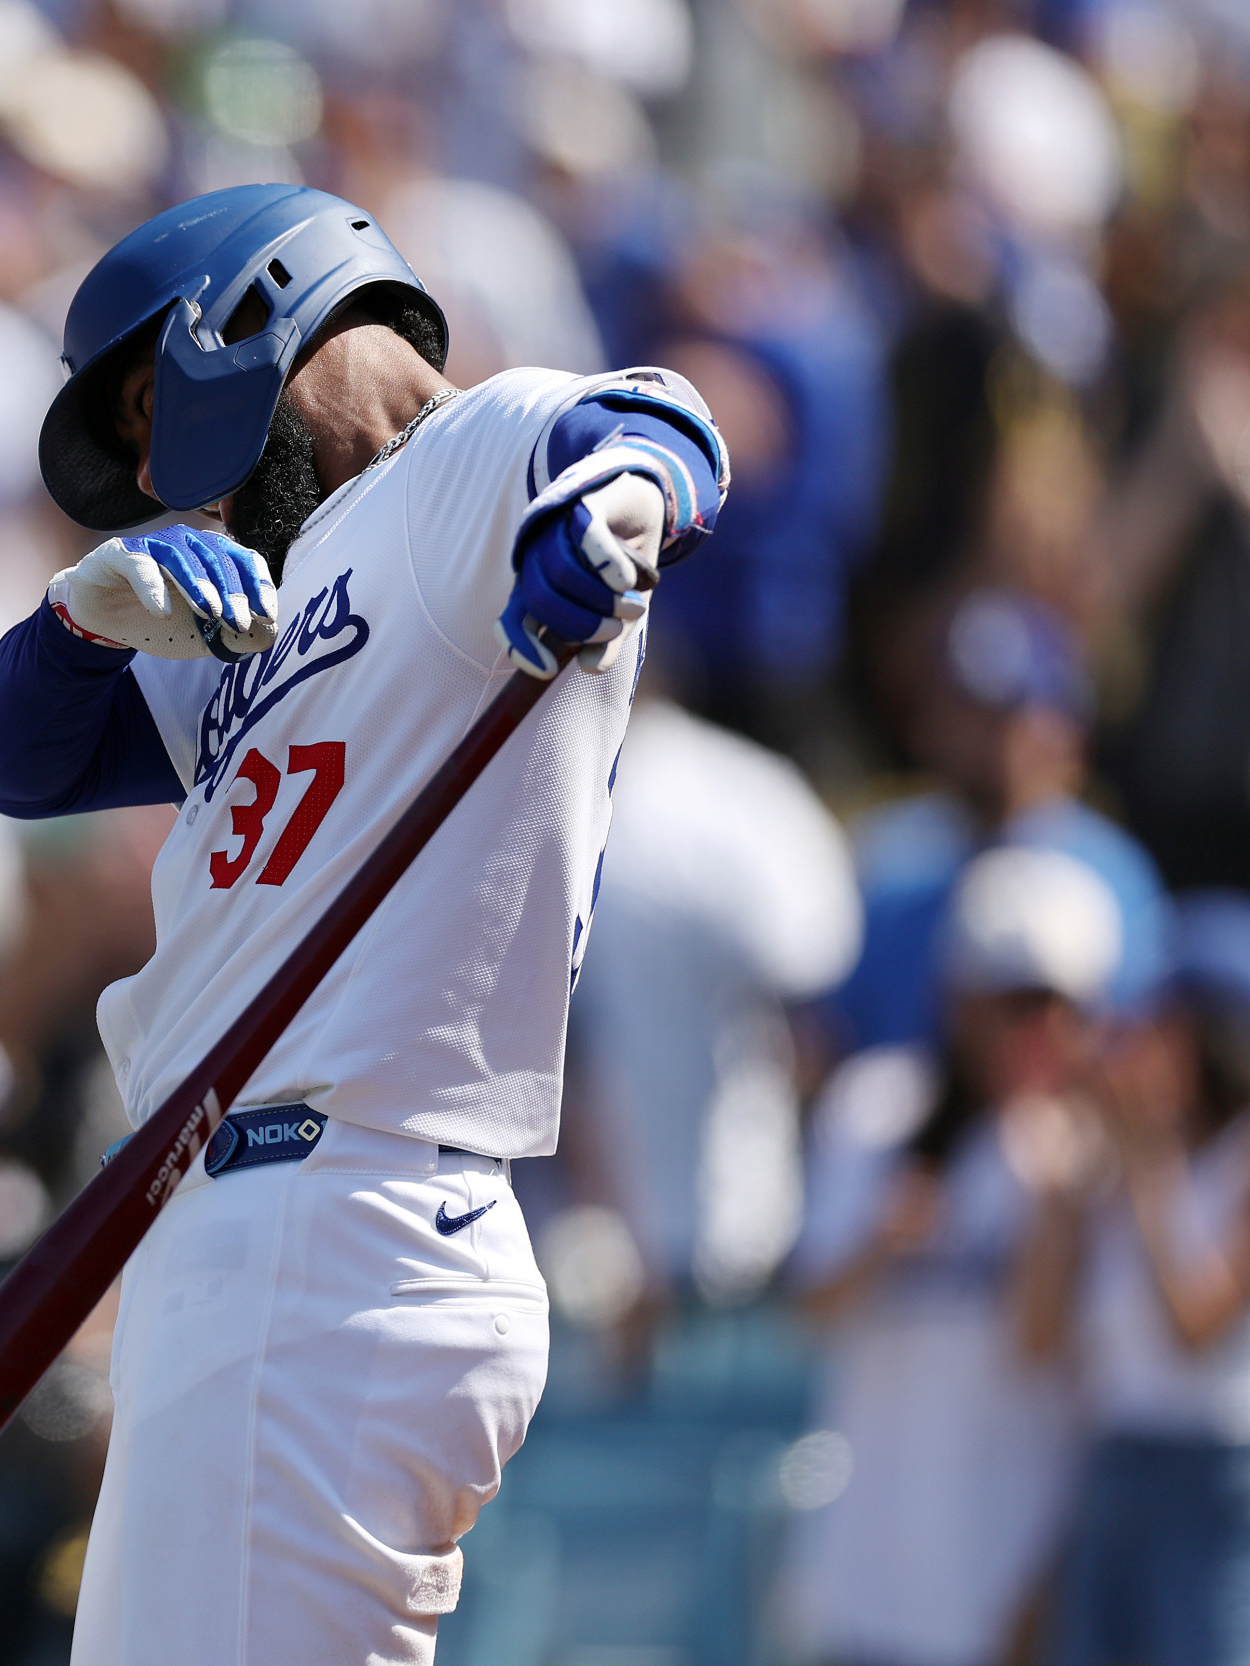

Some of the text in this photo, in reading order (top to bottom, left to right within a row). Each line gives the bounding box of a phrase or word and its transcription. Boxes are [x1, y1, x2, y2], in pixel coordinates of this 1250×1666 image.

[193, 567, 369, 803] odgers
[210, 741, 346, 889] 37
[146, 1105, 206, 1206] marucci
